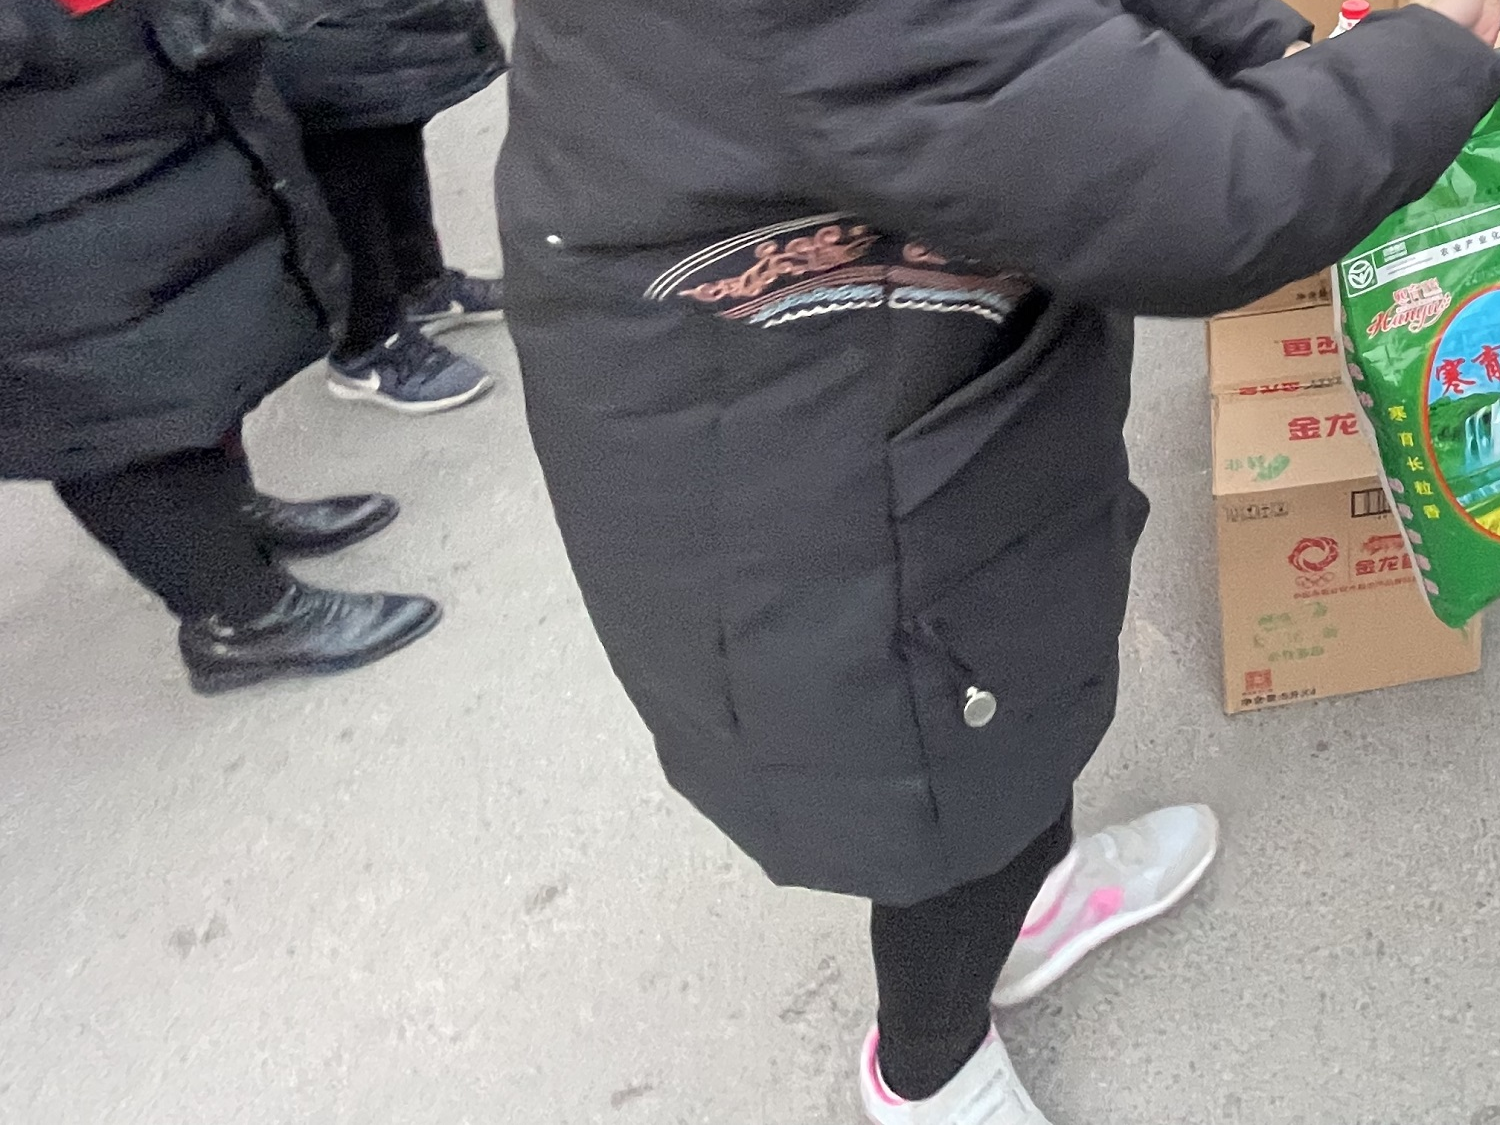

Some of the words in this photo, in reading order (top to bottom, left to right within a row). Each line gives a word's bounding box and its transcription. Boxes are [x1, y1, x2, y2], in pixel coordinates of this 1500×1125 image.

[1288, 412, 1357, 441] 金龙
[1389, 404, 1440, 523] 寒育长粒香
